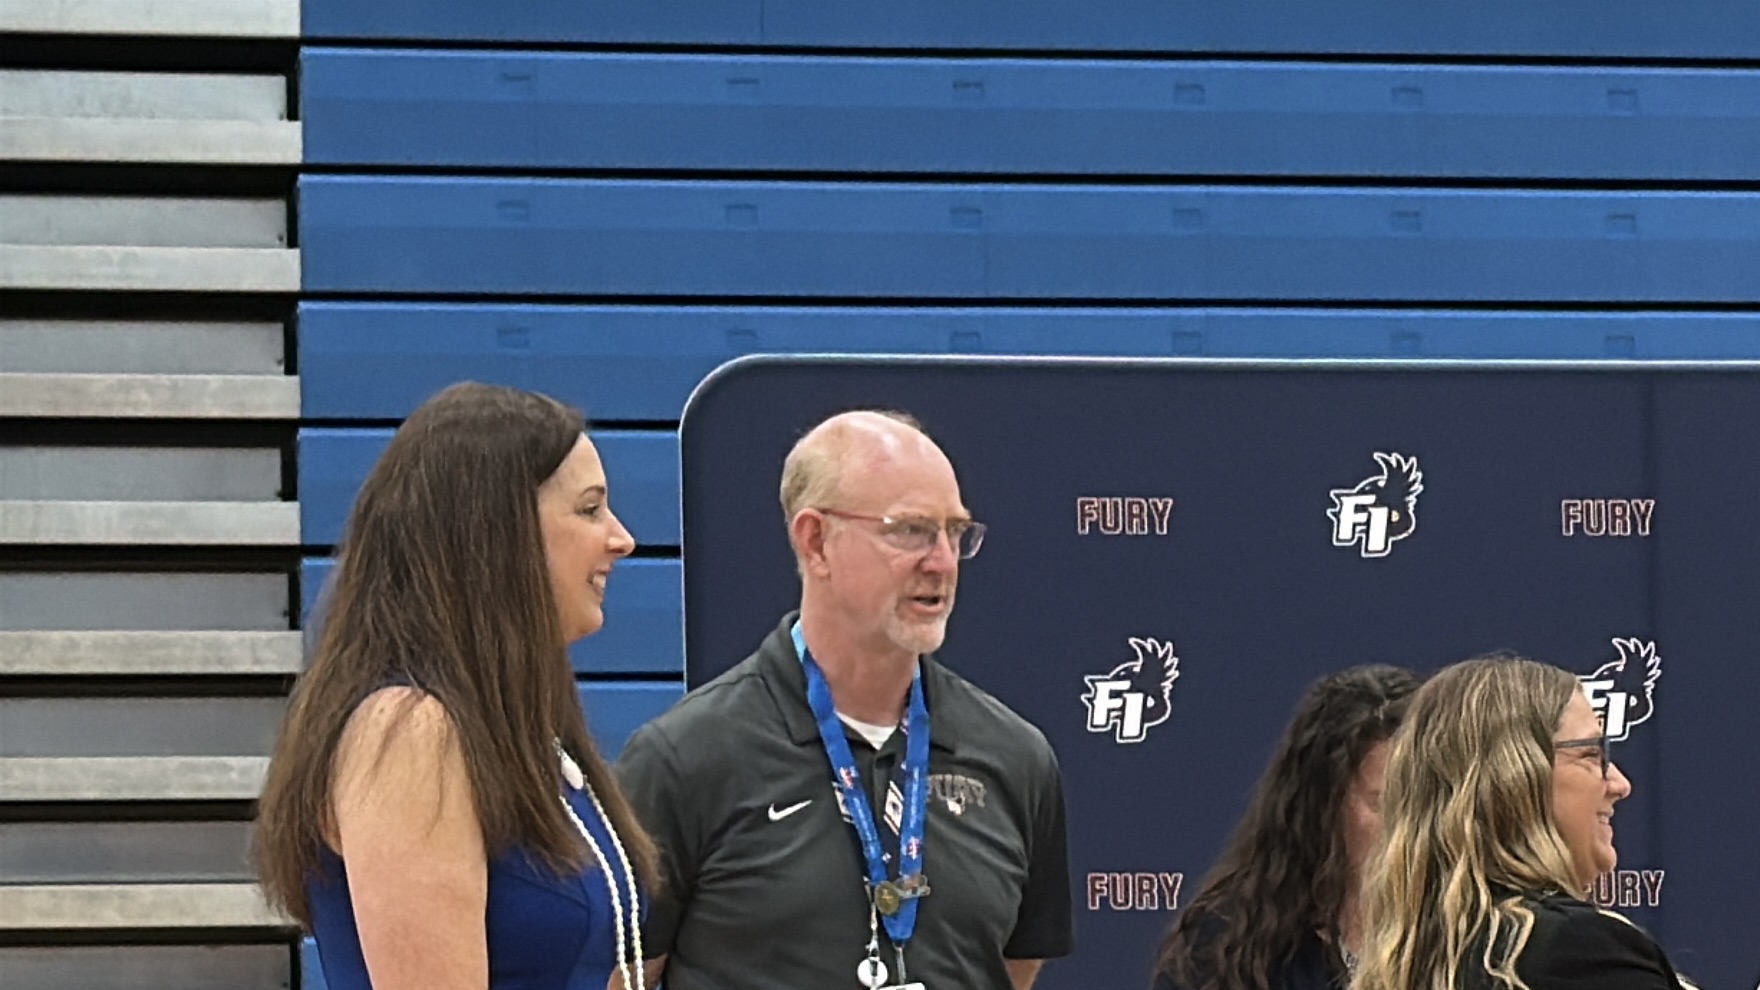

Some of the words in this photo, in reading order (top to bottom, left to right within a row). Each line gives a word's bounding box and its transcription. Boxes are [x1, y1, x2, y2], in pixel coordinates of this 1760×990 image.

[1077, 497, 1174, 536] FURY
[1562, 499, 1656, 536] FURY
[1087, 872, 1184, 911] FURY
[1584, 869, 1665, 907] URY
